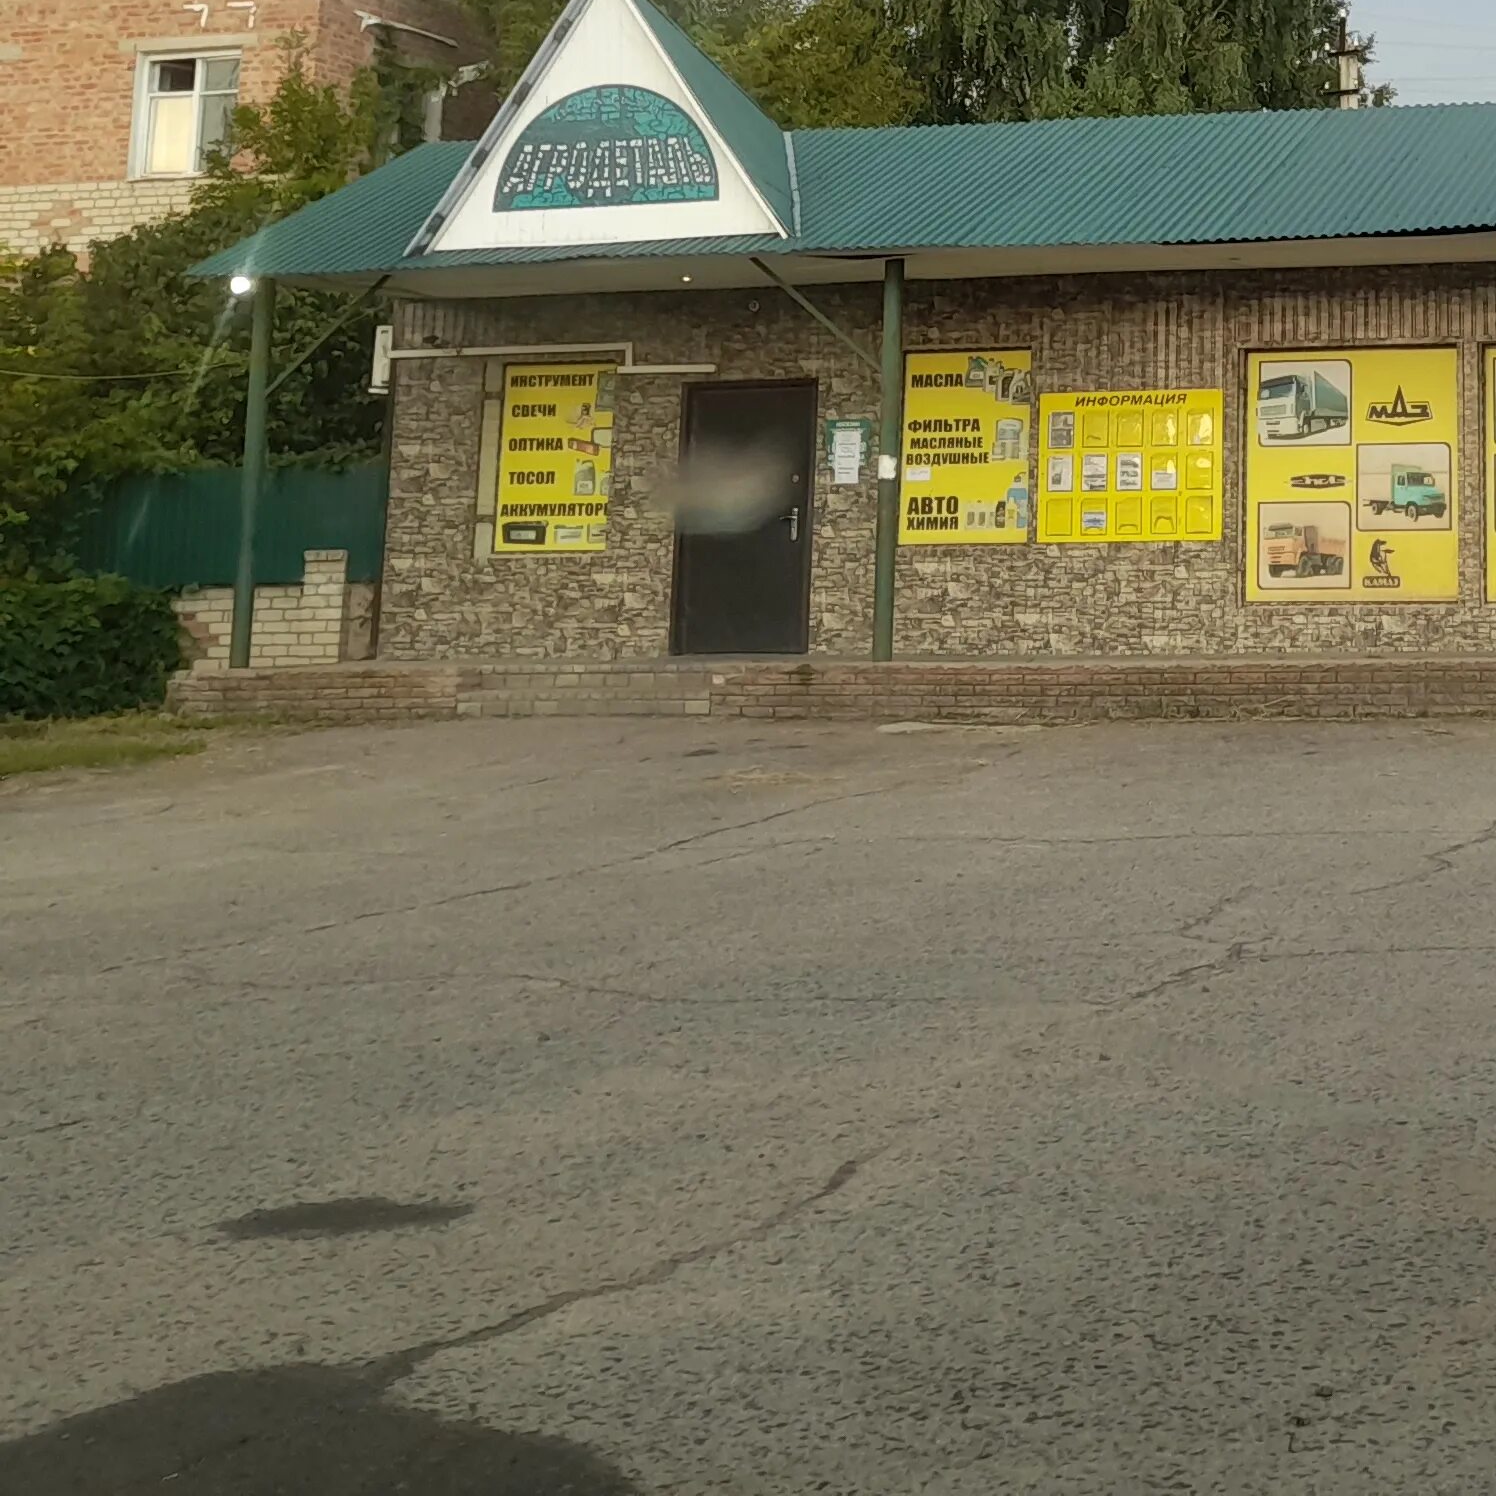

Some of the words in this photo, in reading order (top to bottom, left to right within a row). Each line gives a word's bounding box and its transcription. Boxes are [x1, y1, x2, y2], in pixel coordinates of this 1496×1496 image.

[503, 137, 713, 198] АГРОДЕТАЛЬ
[510, 374, 594, 387] ИНСТРУМЕНТ
[911, 373, 963, 388] МАСЛА
[1075, 393, 1187, 407] ИНФОРМАЦИЯ
[512, 404, 556, 417] СВЕЧИ
[908, 418, 980, 433] ФИЛЬТРА
[508, 438, 563, 452] ОПТИКА
[910, 436, 983, 449] МАСЛЯНЫЕ
[906, 452, 989, 466] ВОЗДУШНЫЕ
[508, 471, 555, 485] ТОСОЛ
[500, 502, 608, 517] АККУМУЛЯТОР
[907, 495, 959, 515] АВТО
[906, 516, 959, 531] ХИМИЯ
